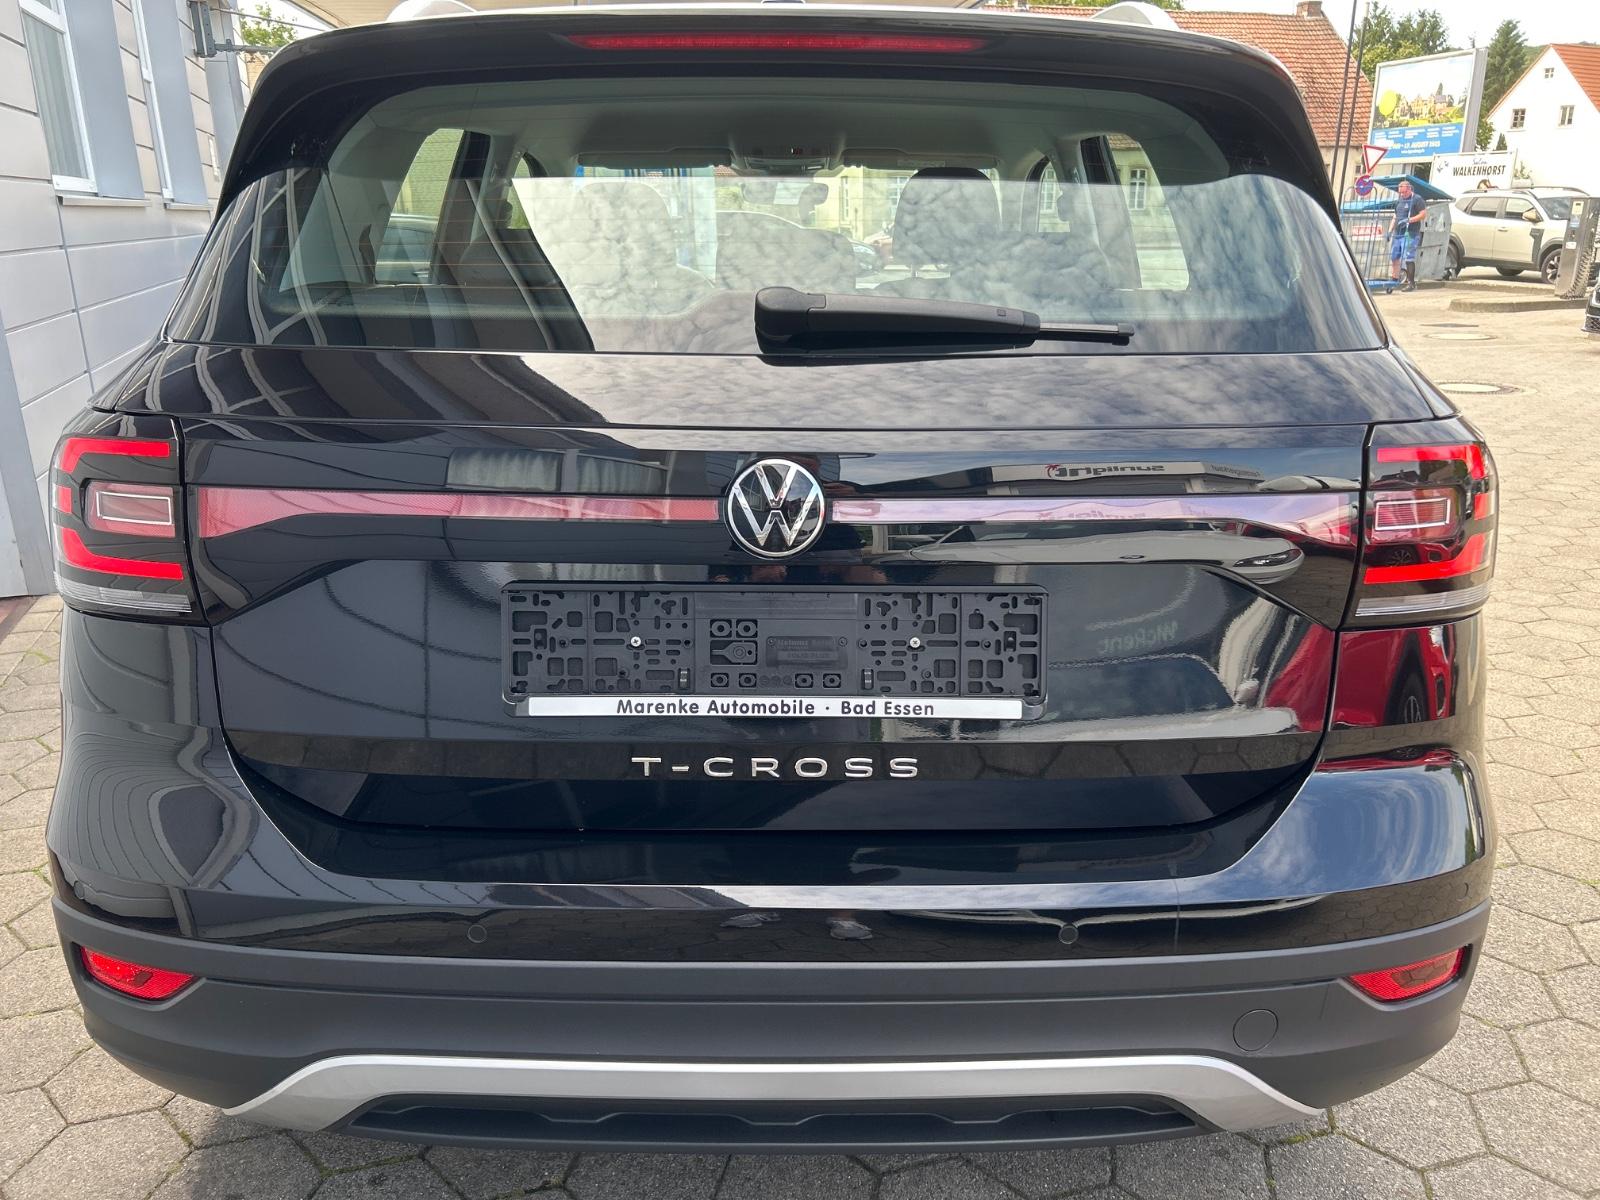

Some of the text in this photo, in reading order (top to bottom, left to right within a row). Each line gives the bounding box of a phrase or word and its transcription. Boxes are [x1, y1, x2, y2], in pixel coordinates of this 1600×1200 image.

[1453, 165, 1507, 176] WALKENHORST
[616, 699, 934, 716] Marenke Automobile Bad Essen
[631, 757, 918, 778] T-CROSS
